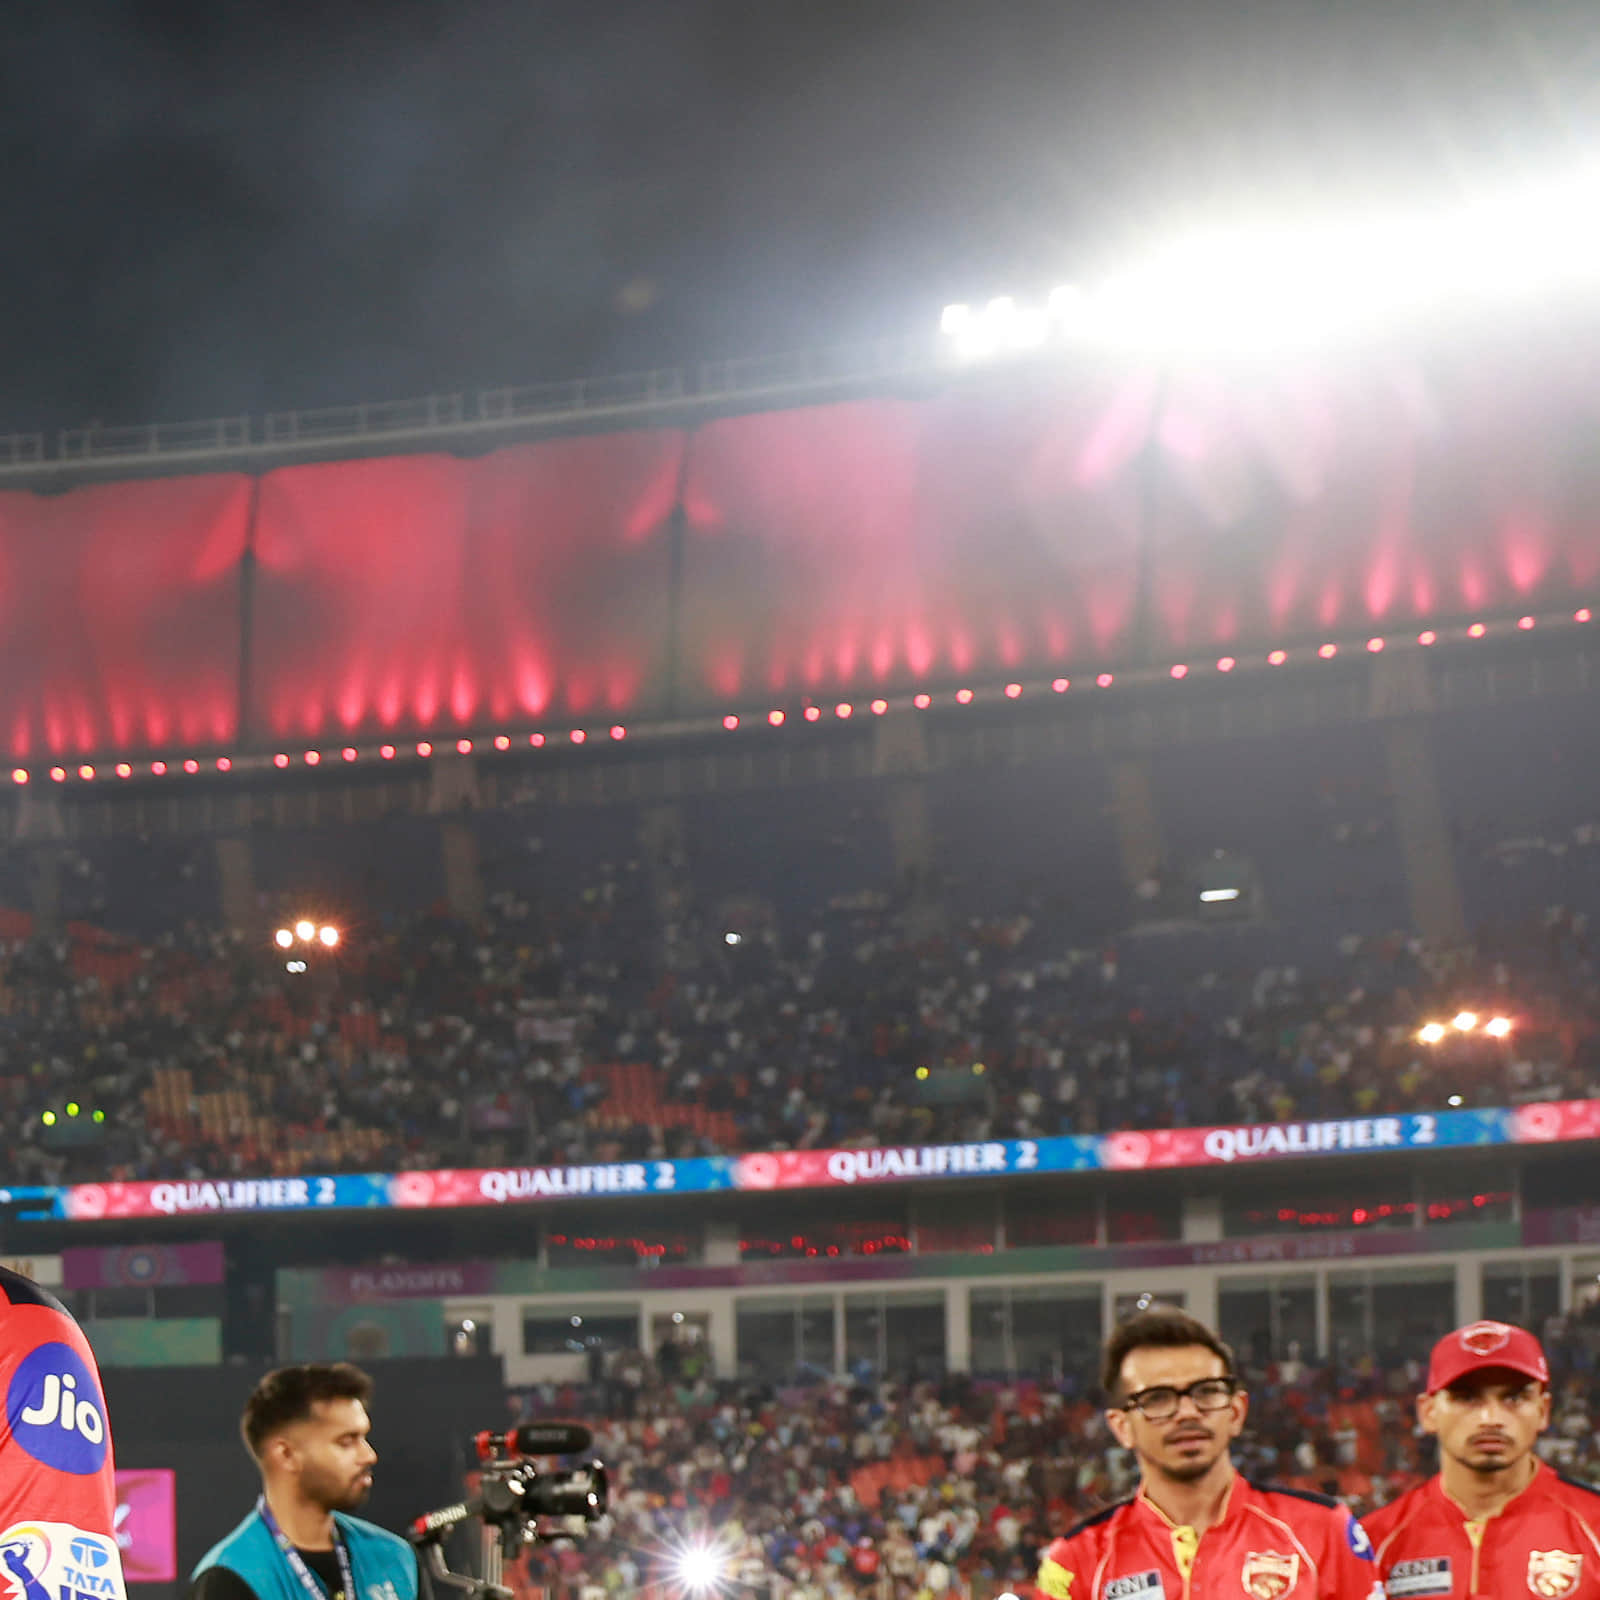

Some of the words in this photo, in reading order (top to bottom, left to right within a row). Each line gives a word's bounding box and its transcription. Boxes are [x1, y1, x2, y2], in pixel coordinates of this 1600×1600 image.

[1204, 1117, 1402, 1161] QUALIFIER
[1411, 1115, 1436, 1143] 2
[479, 1164, 646, 1200] QUALIFIER
[654, 1162, 675, 1190] 2
[827, 1143, 1006, 1183] QUALIFIER
[1015, 1141, 1039, 1168] 2
[150, 1181, 307, 1212] QUALIFIER
[314, 1178, 337, 1204] 2
[21, 1373, 103, 1444] Jio
[63, 1566, 116, 1595] TATA
